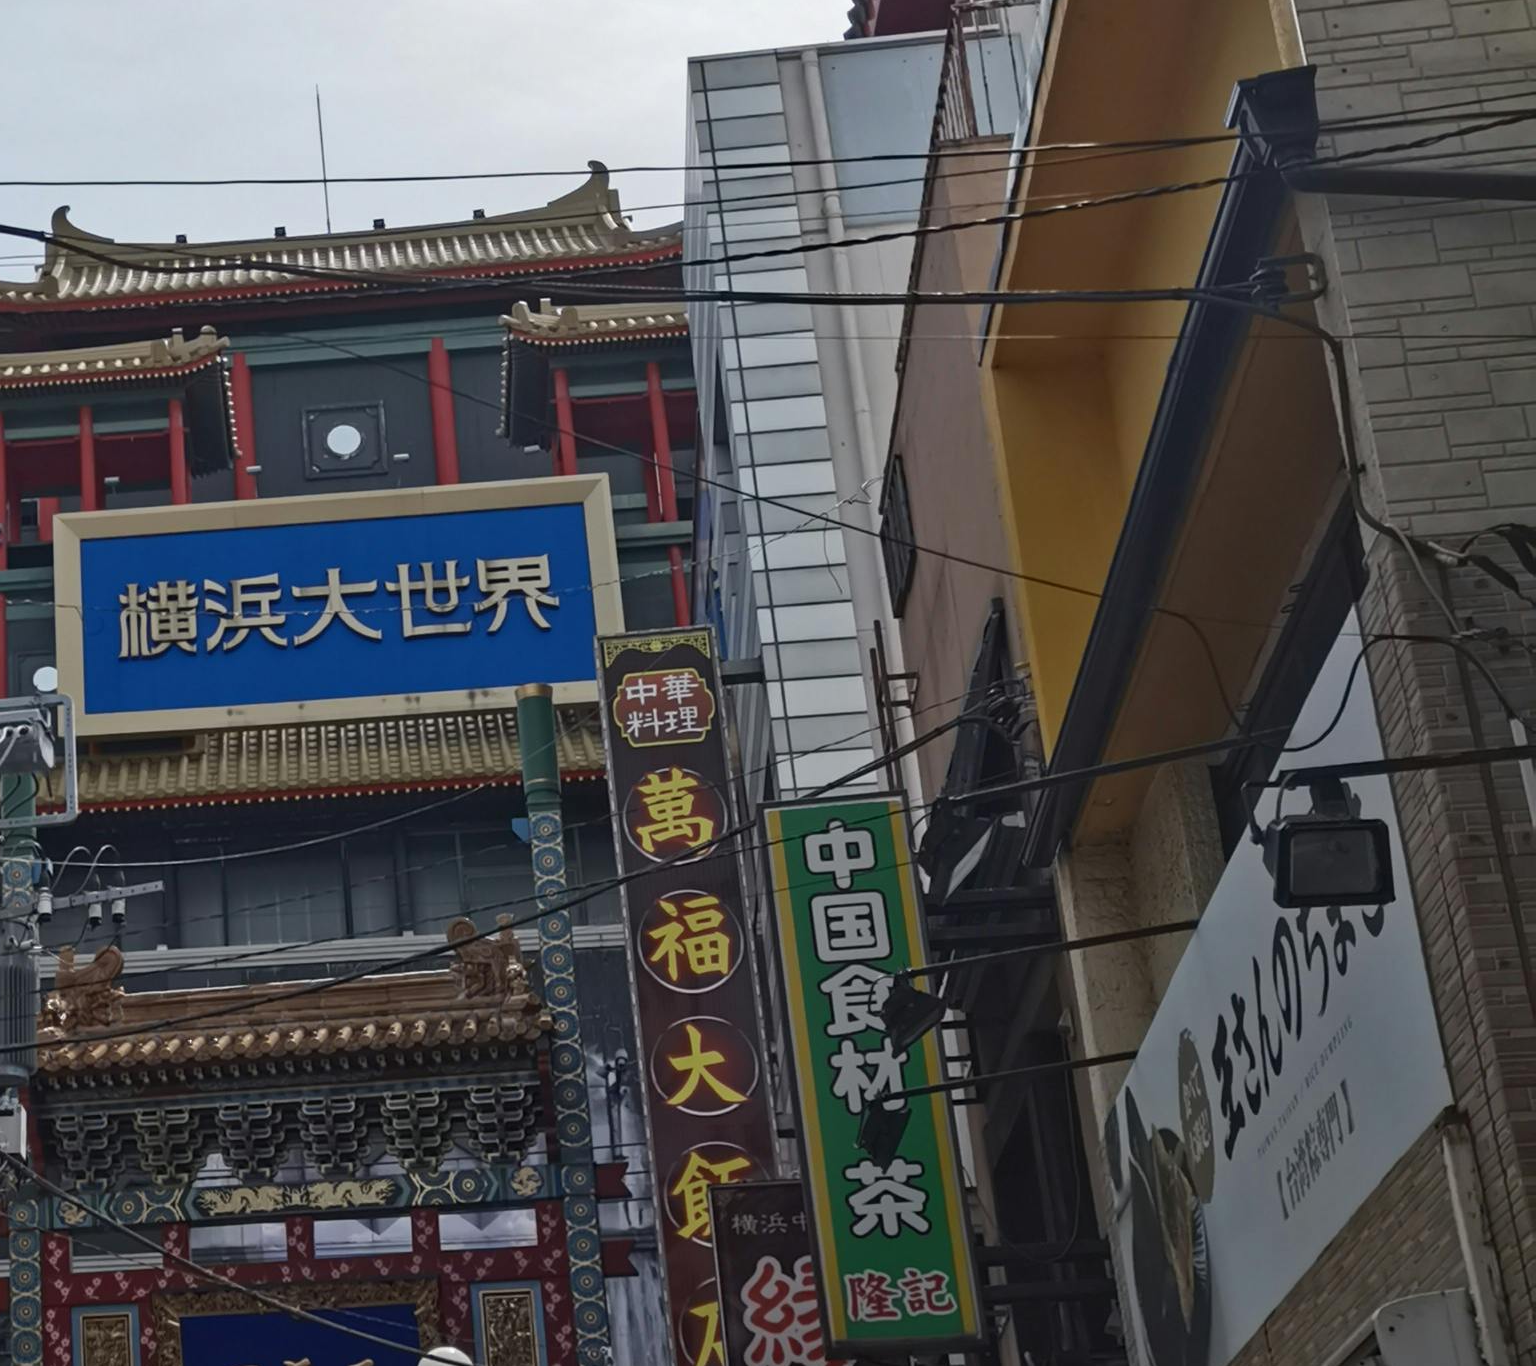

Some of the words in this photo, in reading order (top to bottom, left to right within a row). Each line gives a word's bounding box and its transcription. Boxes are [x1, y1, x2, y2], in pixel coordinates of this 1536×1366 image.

[117, 552, 561, 660] 横浜大世界
[625, 672, 701, 706] 中華
[626, 705, 706, 738] 料理
[844, 1156, 930, 1238] 茶
[845, 1265, 958, 1324] 隆記
